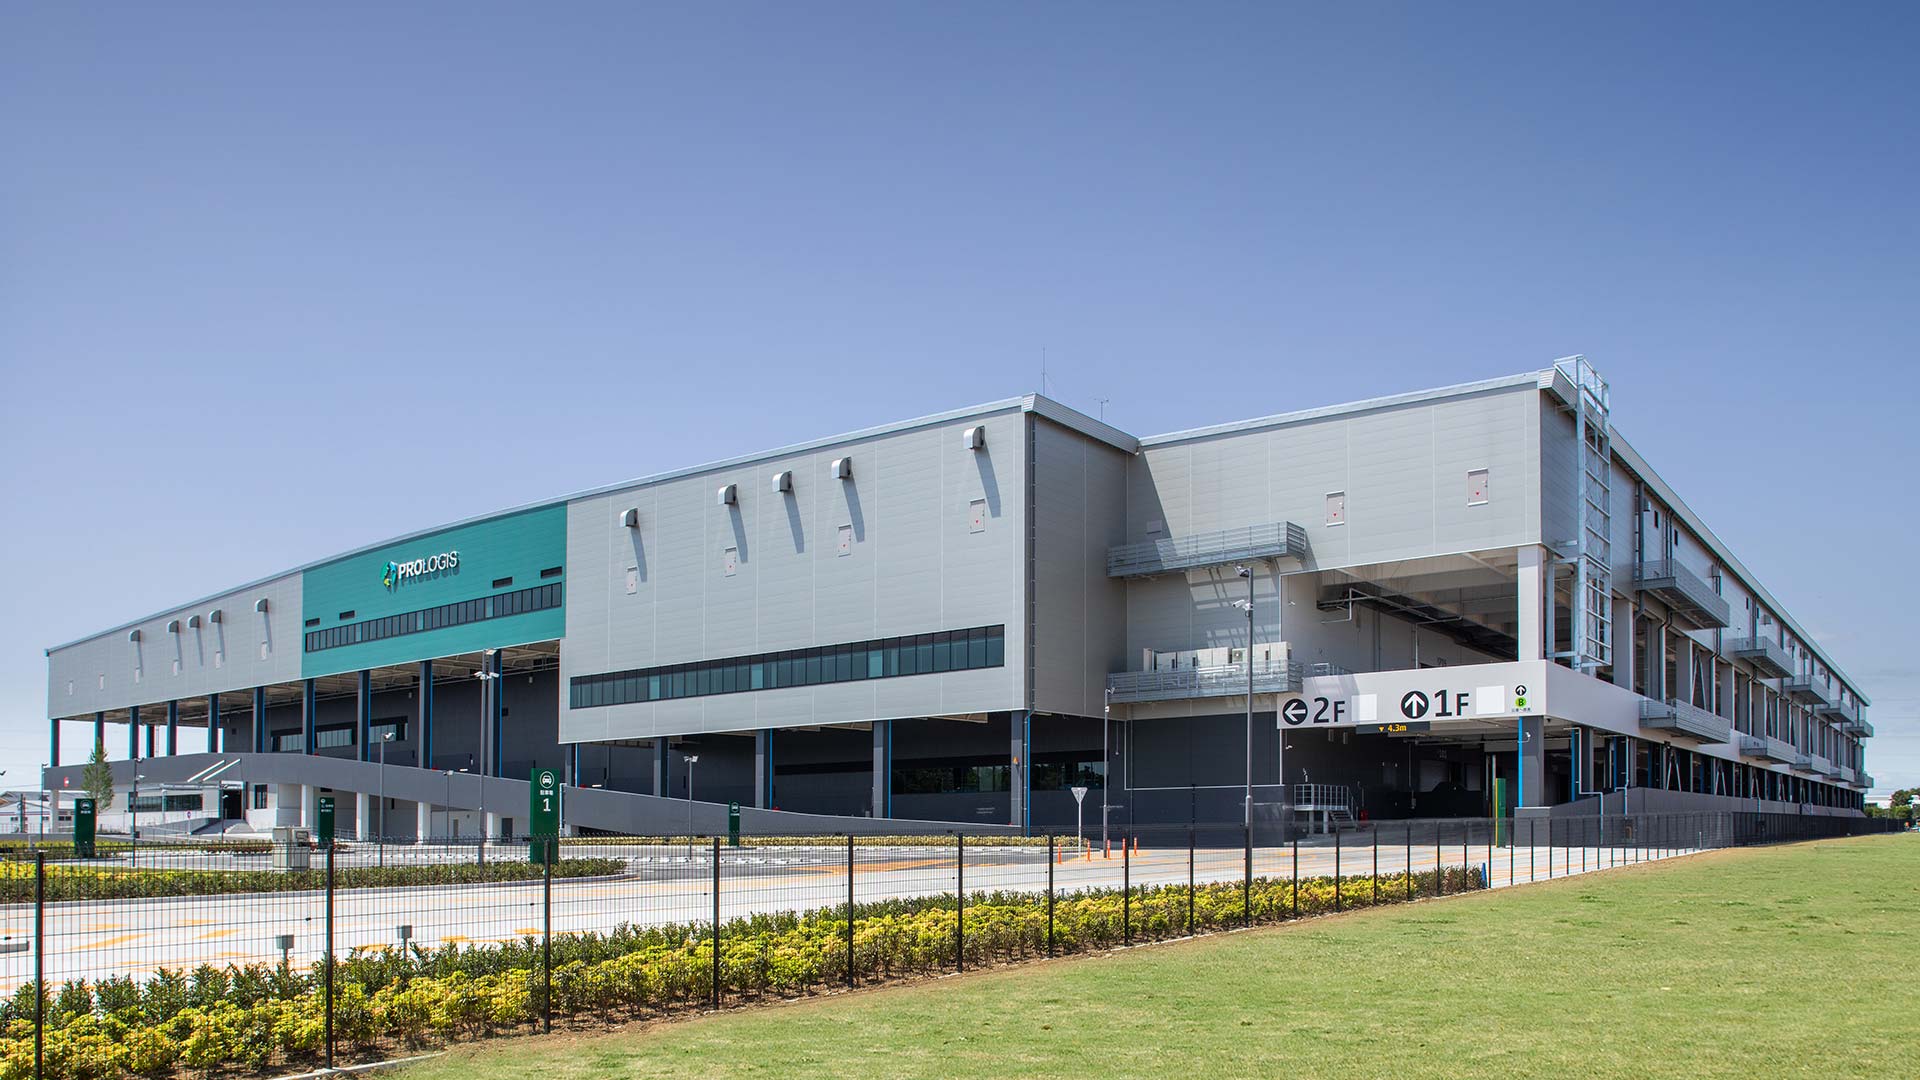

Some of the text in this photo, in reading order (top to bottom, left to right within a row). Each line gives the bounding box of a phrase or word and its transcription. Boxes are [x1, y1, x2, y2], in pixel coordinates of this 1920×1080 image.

[398, 551, 458, 579] PROLOGIS
[1313, 697, 1345, 724] 2F
[1434, 690, 1469, 717] 1F
[1387, 724, 1407, 733] 4.3m
[543, 798, 551, 812] 1
